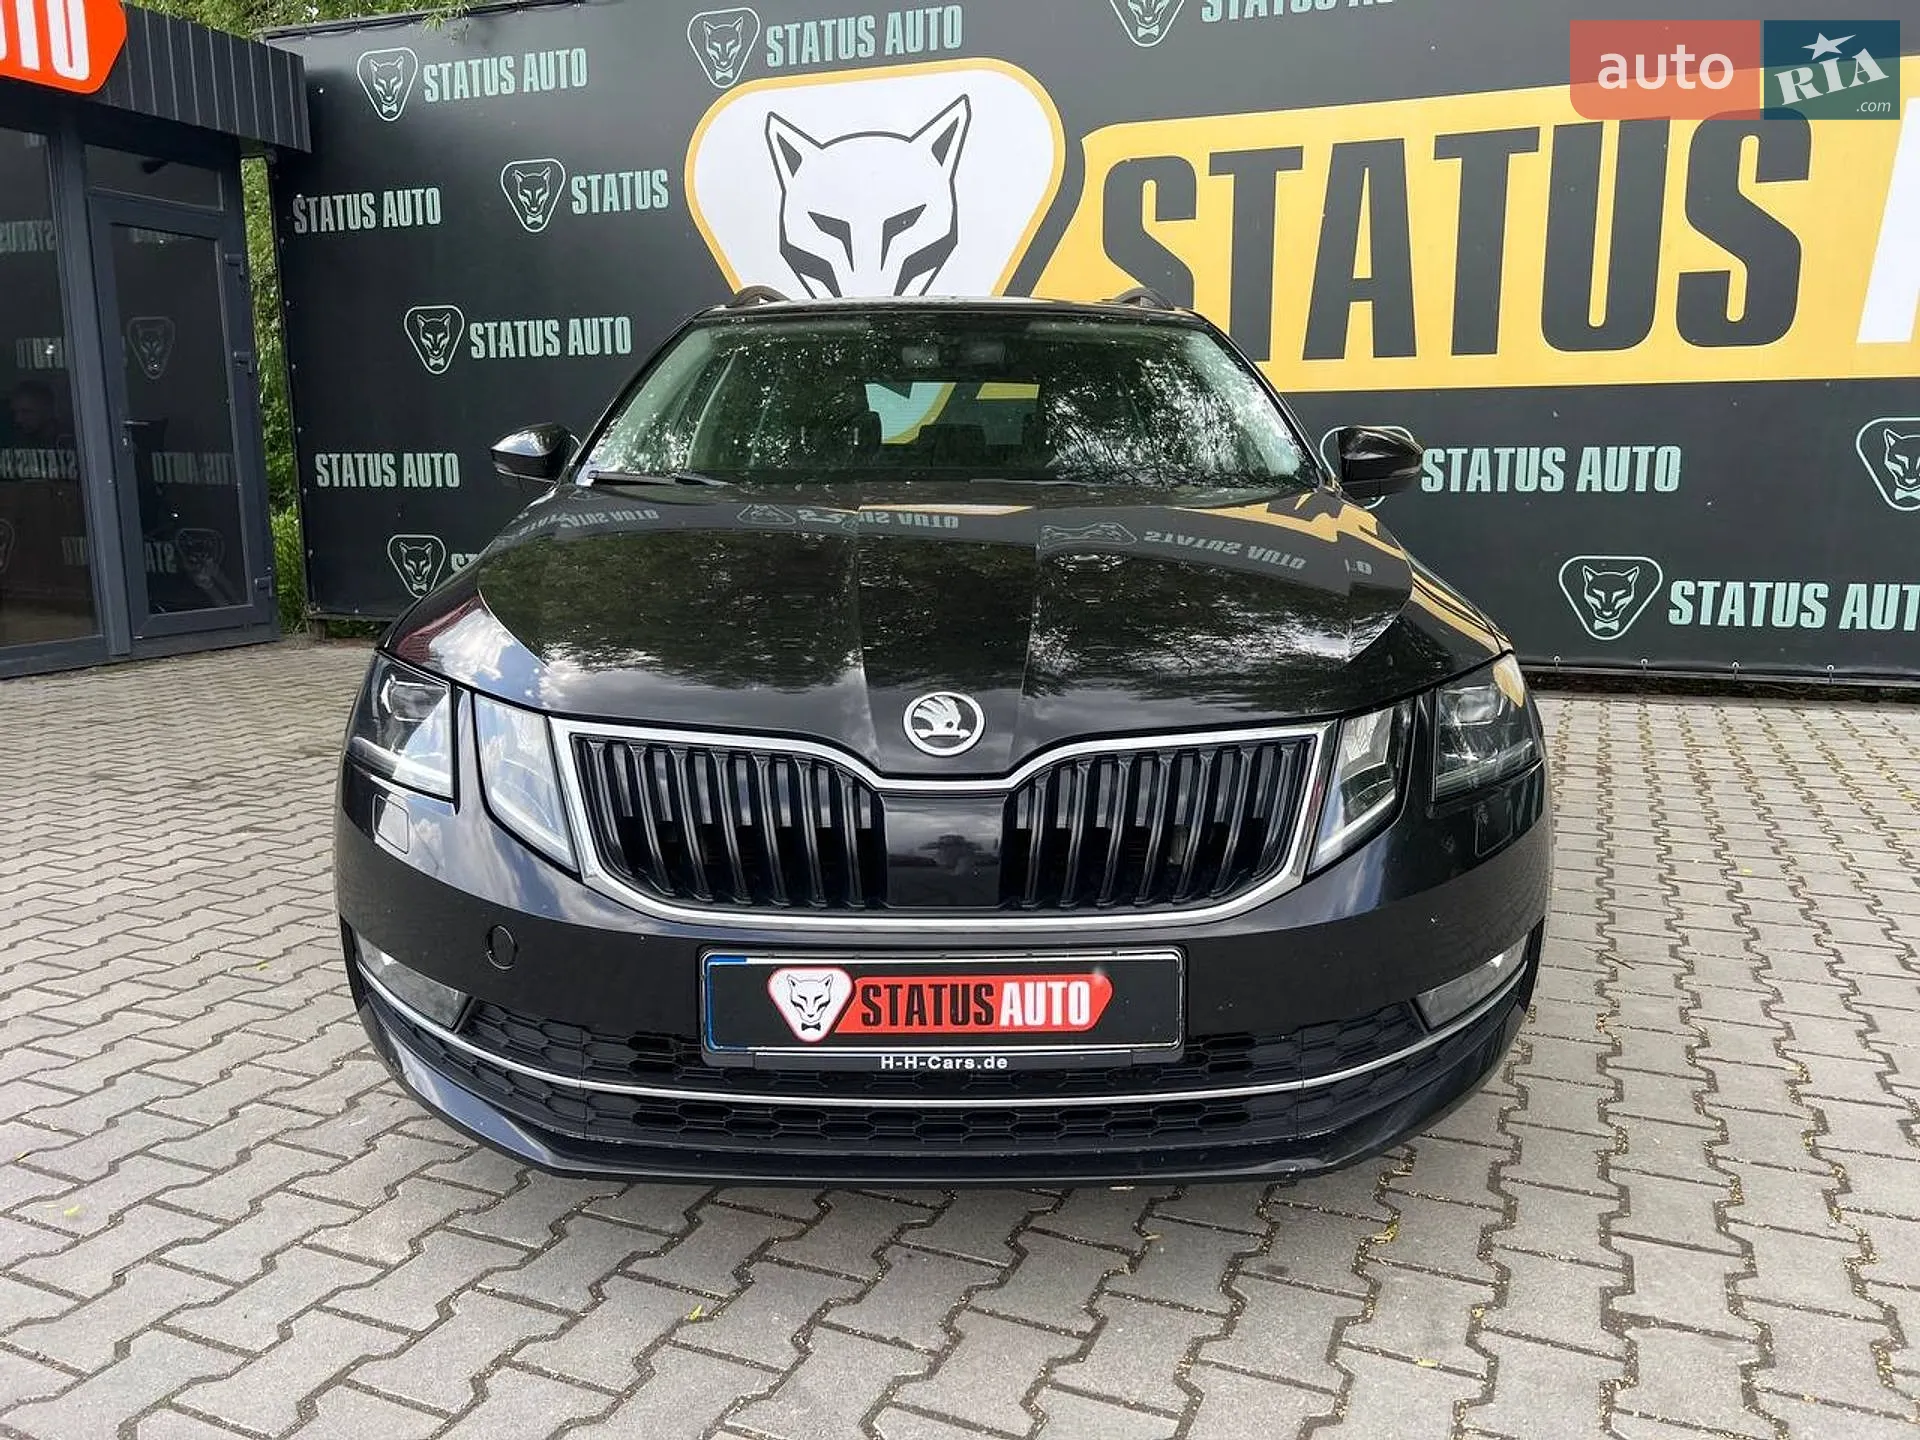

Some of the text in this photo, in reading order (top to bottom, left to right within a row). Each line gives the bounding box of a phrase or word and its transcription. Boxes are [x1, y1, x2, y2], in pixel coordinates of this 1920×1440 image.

[766, 5, 963, 67] STATUS AUTO
[423, 48, 587, 102] STATUS AUTO
[292, 187, 441, 234] STATUS AUTO
[571, 169, 668, 214] STATUS
[1102, 107, 1812, 361] STATUS
[469, 316, 632, 359] STATUS AUTO
[315, 453, 460, 487] STATUS AUTO
[1421, 446, 1681, 492] STATUS AUTO
[1668, 580, 1829, 629] STATUS
[861, 981, 1091, 1027] STATUS AUTO
[880, 1056, 1008, 1070] H-H-Cars.de
